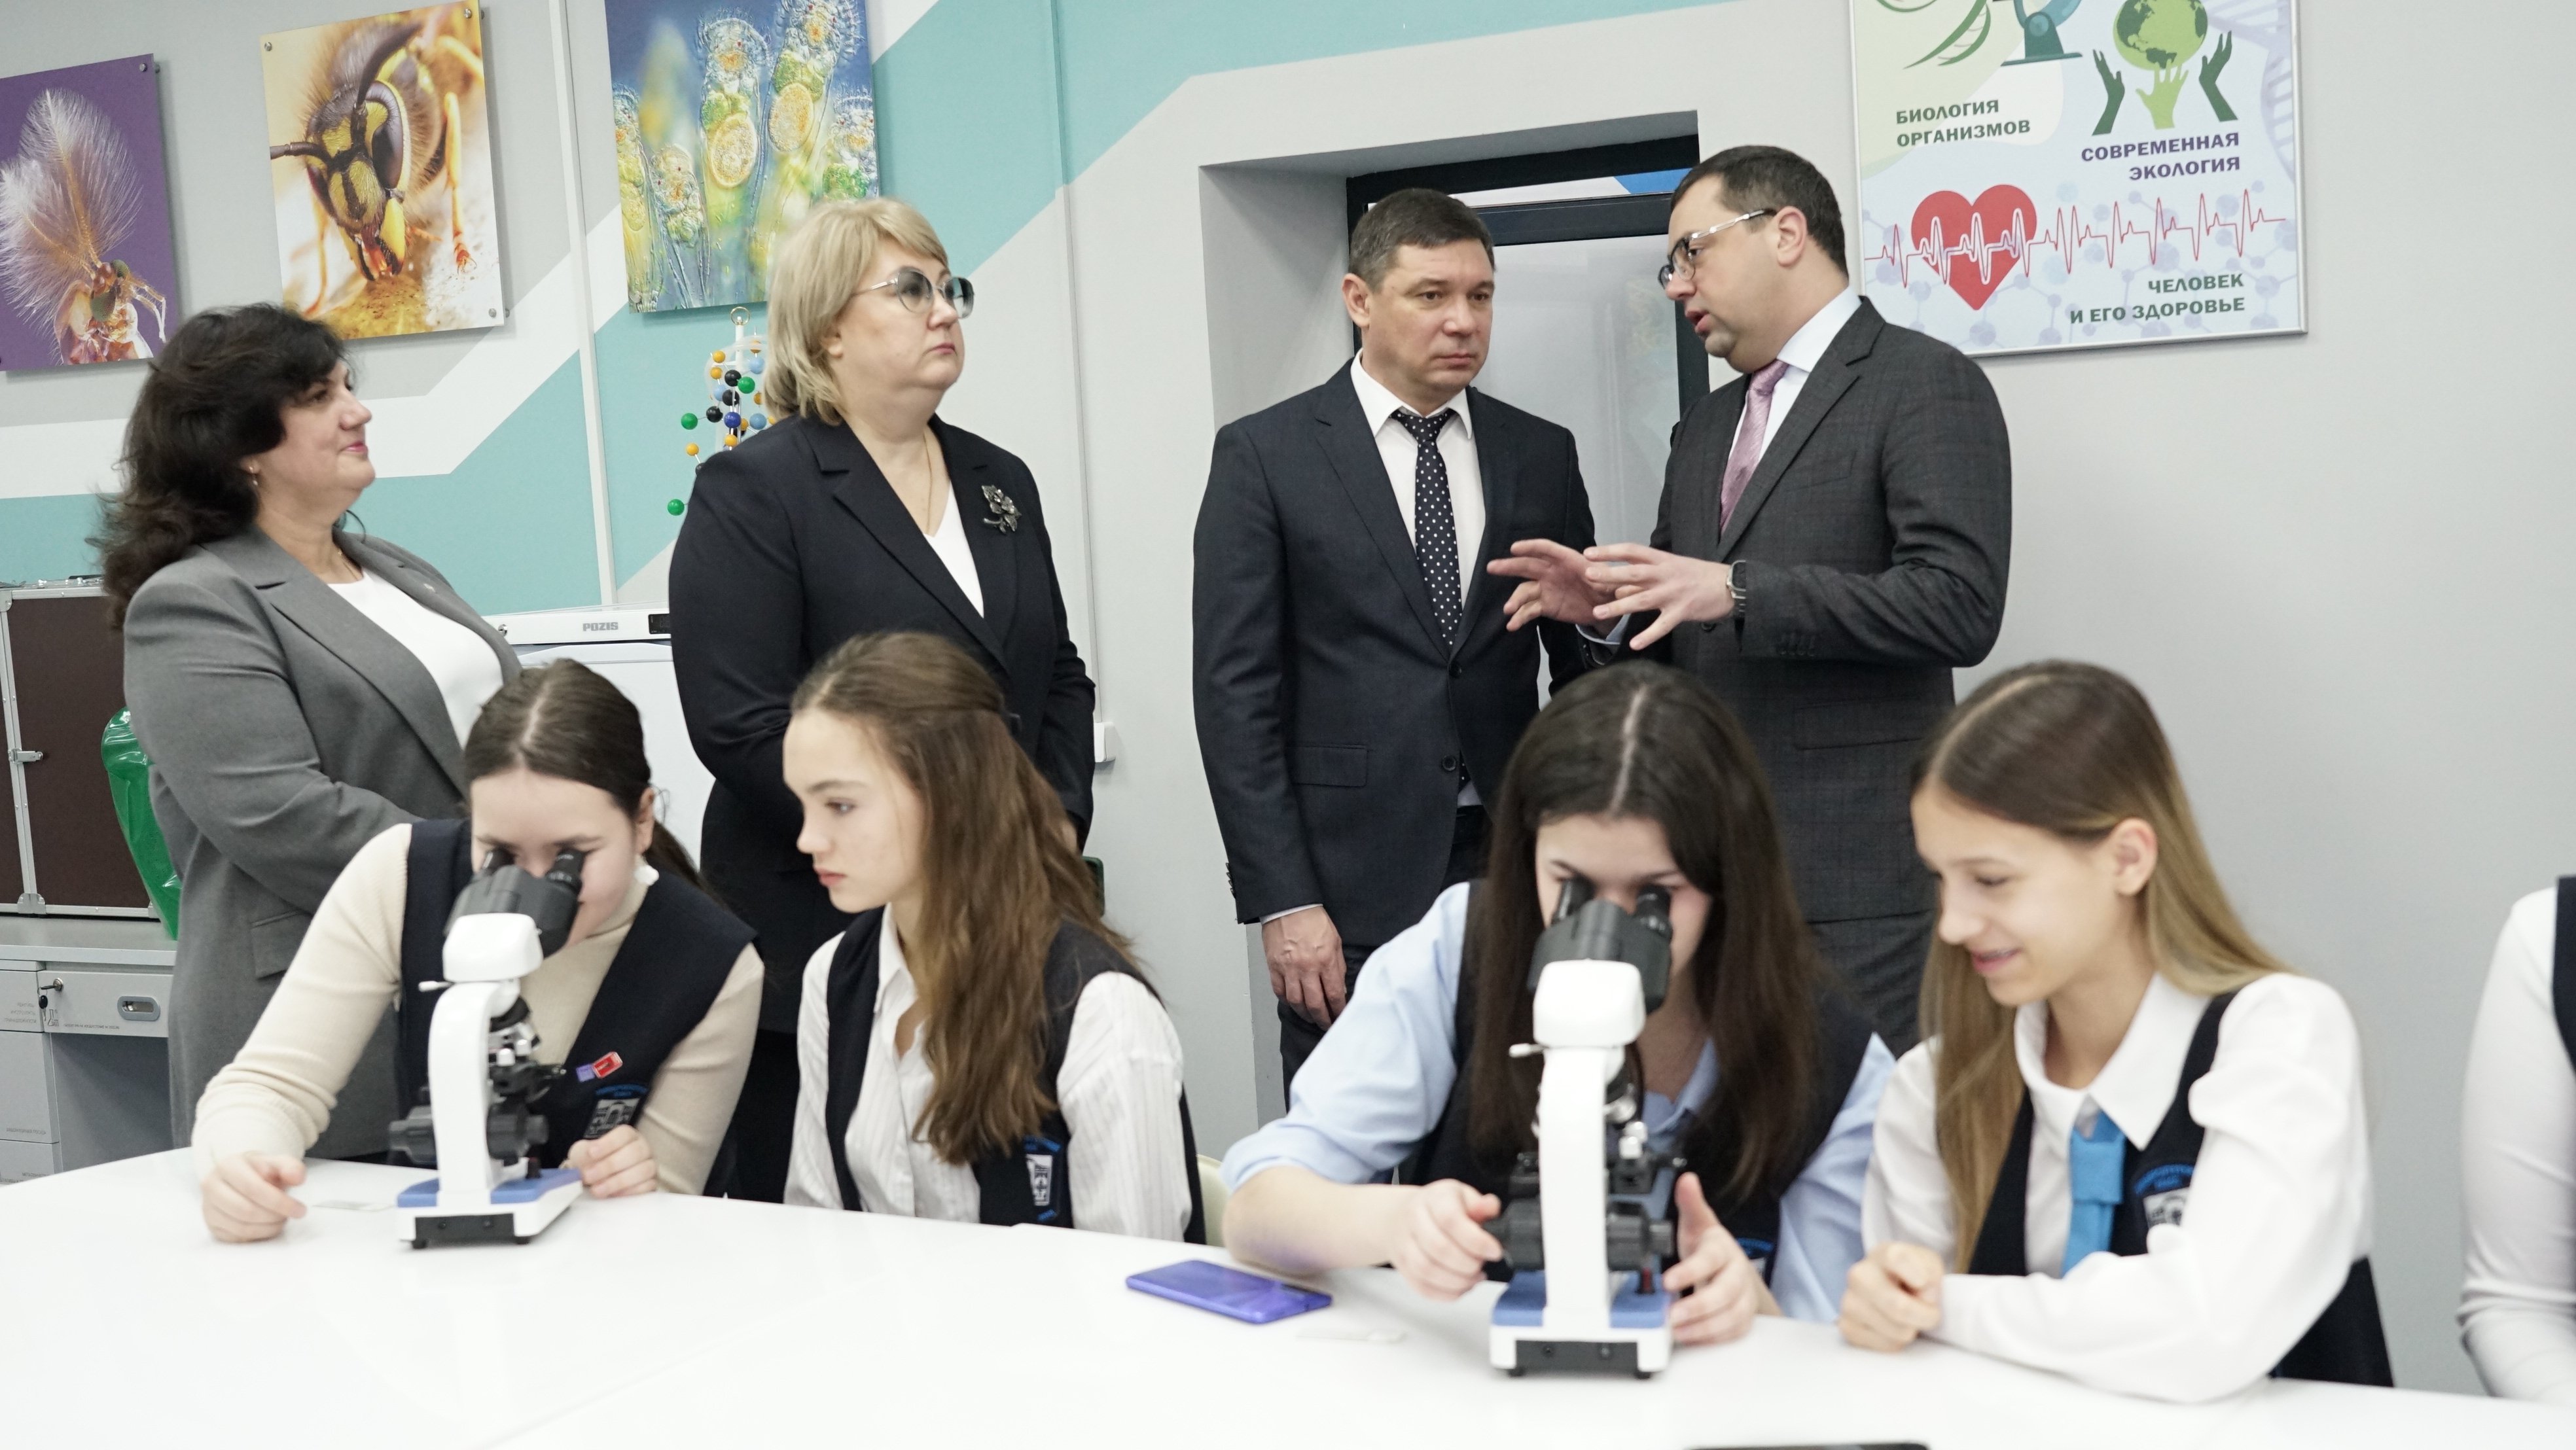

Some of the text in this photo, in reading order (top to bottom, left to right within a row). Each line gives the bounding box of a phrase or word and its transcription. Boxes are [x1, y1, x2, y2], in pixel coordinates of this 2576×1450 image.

[1896, 99, 1999, 124] БИОЛОГИЯ
[1897, 120, 2031, 147] ОРГАНИЗМОВ
[2081, 132, 2240, 162] СОВРЕМЕННАЯ
[2128, 156, 2240, 181] ЭКОЛОГИЯ
[2148, 273, 2244, 294] ЧЕЛОВЕК
[2069, 297, 2245, 324] И ЕГО ЗДОРОВЬЕ
[582, 622, 618, 631] POZIS
